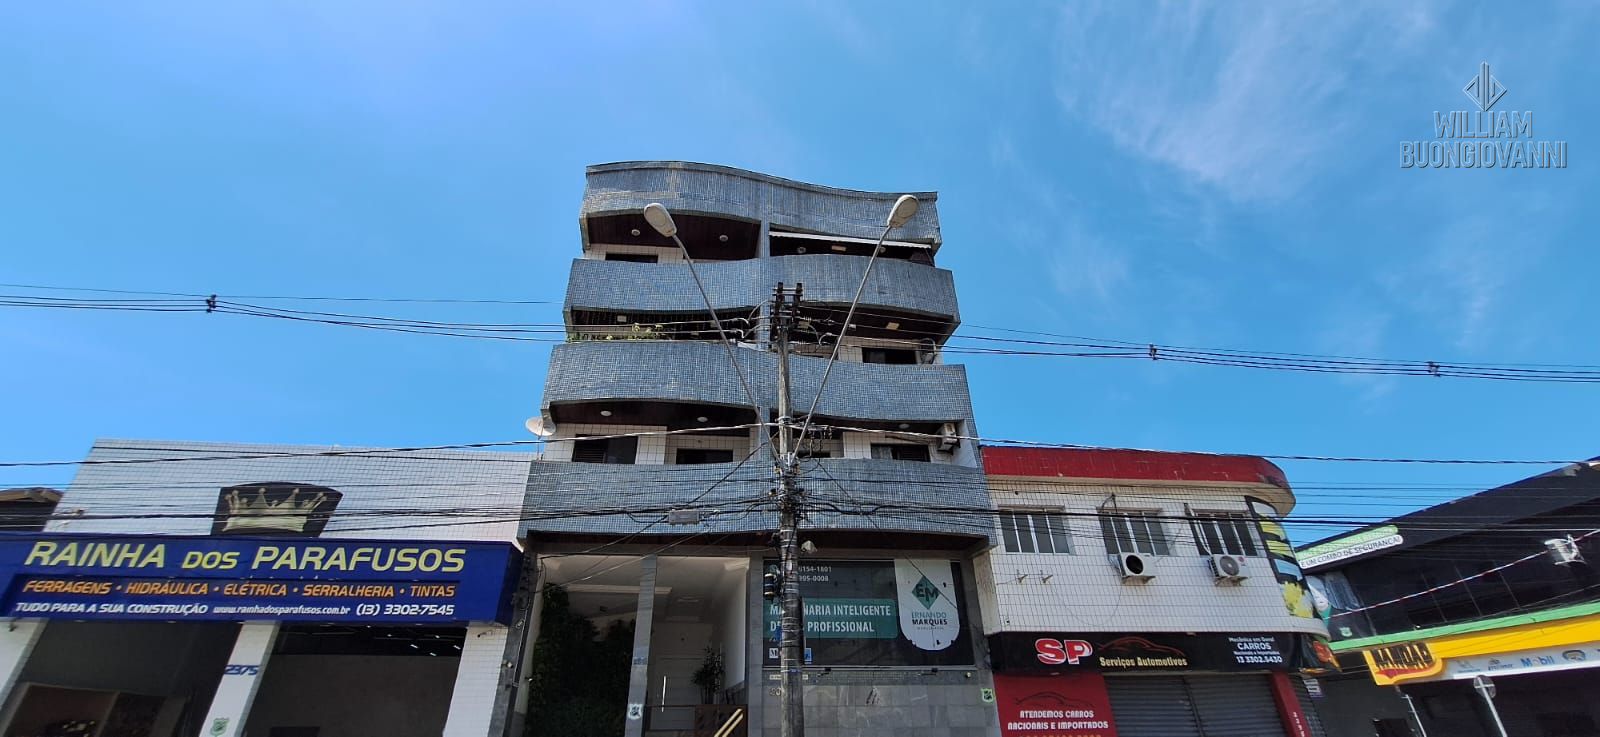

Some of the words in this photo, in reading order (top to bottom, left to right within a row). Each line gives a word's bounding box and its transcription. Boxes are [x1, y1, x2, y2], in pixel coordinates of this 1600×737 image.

[24, 541, 166, 568] RAINHA
[181, 551, 240, 569] DOS
[251, 546, 466, 572] PARAFUSOS
[22, 580, 113, 595] FERRAGENS
[124, 580, 209, 595] HIDRÁULICA
[223, 581, 287, 596] ELÉTRICA
[302, 584, 394, 597] SERRALHERIA
[410, 585, 455, 597] TINTAS
[16, 603, 50, 612] TUDO
[51, 604, 85, 613] PARA
[86, 604, 97, 613] A
[99, 604, 124, 613] SUA
[126, 603, 208, 617] CONSTRUÇÃO
[356, 604, 380, 616] (13)
[384, 604, 454, 616] 3302-7545
[833, 605, 891, 616] INTELIGENTE
[807, 620, 875, 632] PROFISSIONAL
[912, 619, 948, 627] MARQUES
[1035, 638, 1093, 664] SP
[1237, 642, 1272, 650] CARROS
[1100, 656, 1136, 669] Serviços
[1137, 656, 1187, 666] Automotivos
[1020, 710, 1064, 719] ATENDEMOS
[1065, 710, 1095, 719] CARROS
[1007, 722, 1049, 730] NACIONAIS
[1050, 722, 1056, 730] E
[1057, 721, 1109, 730] IMPORTADOS
